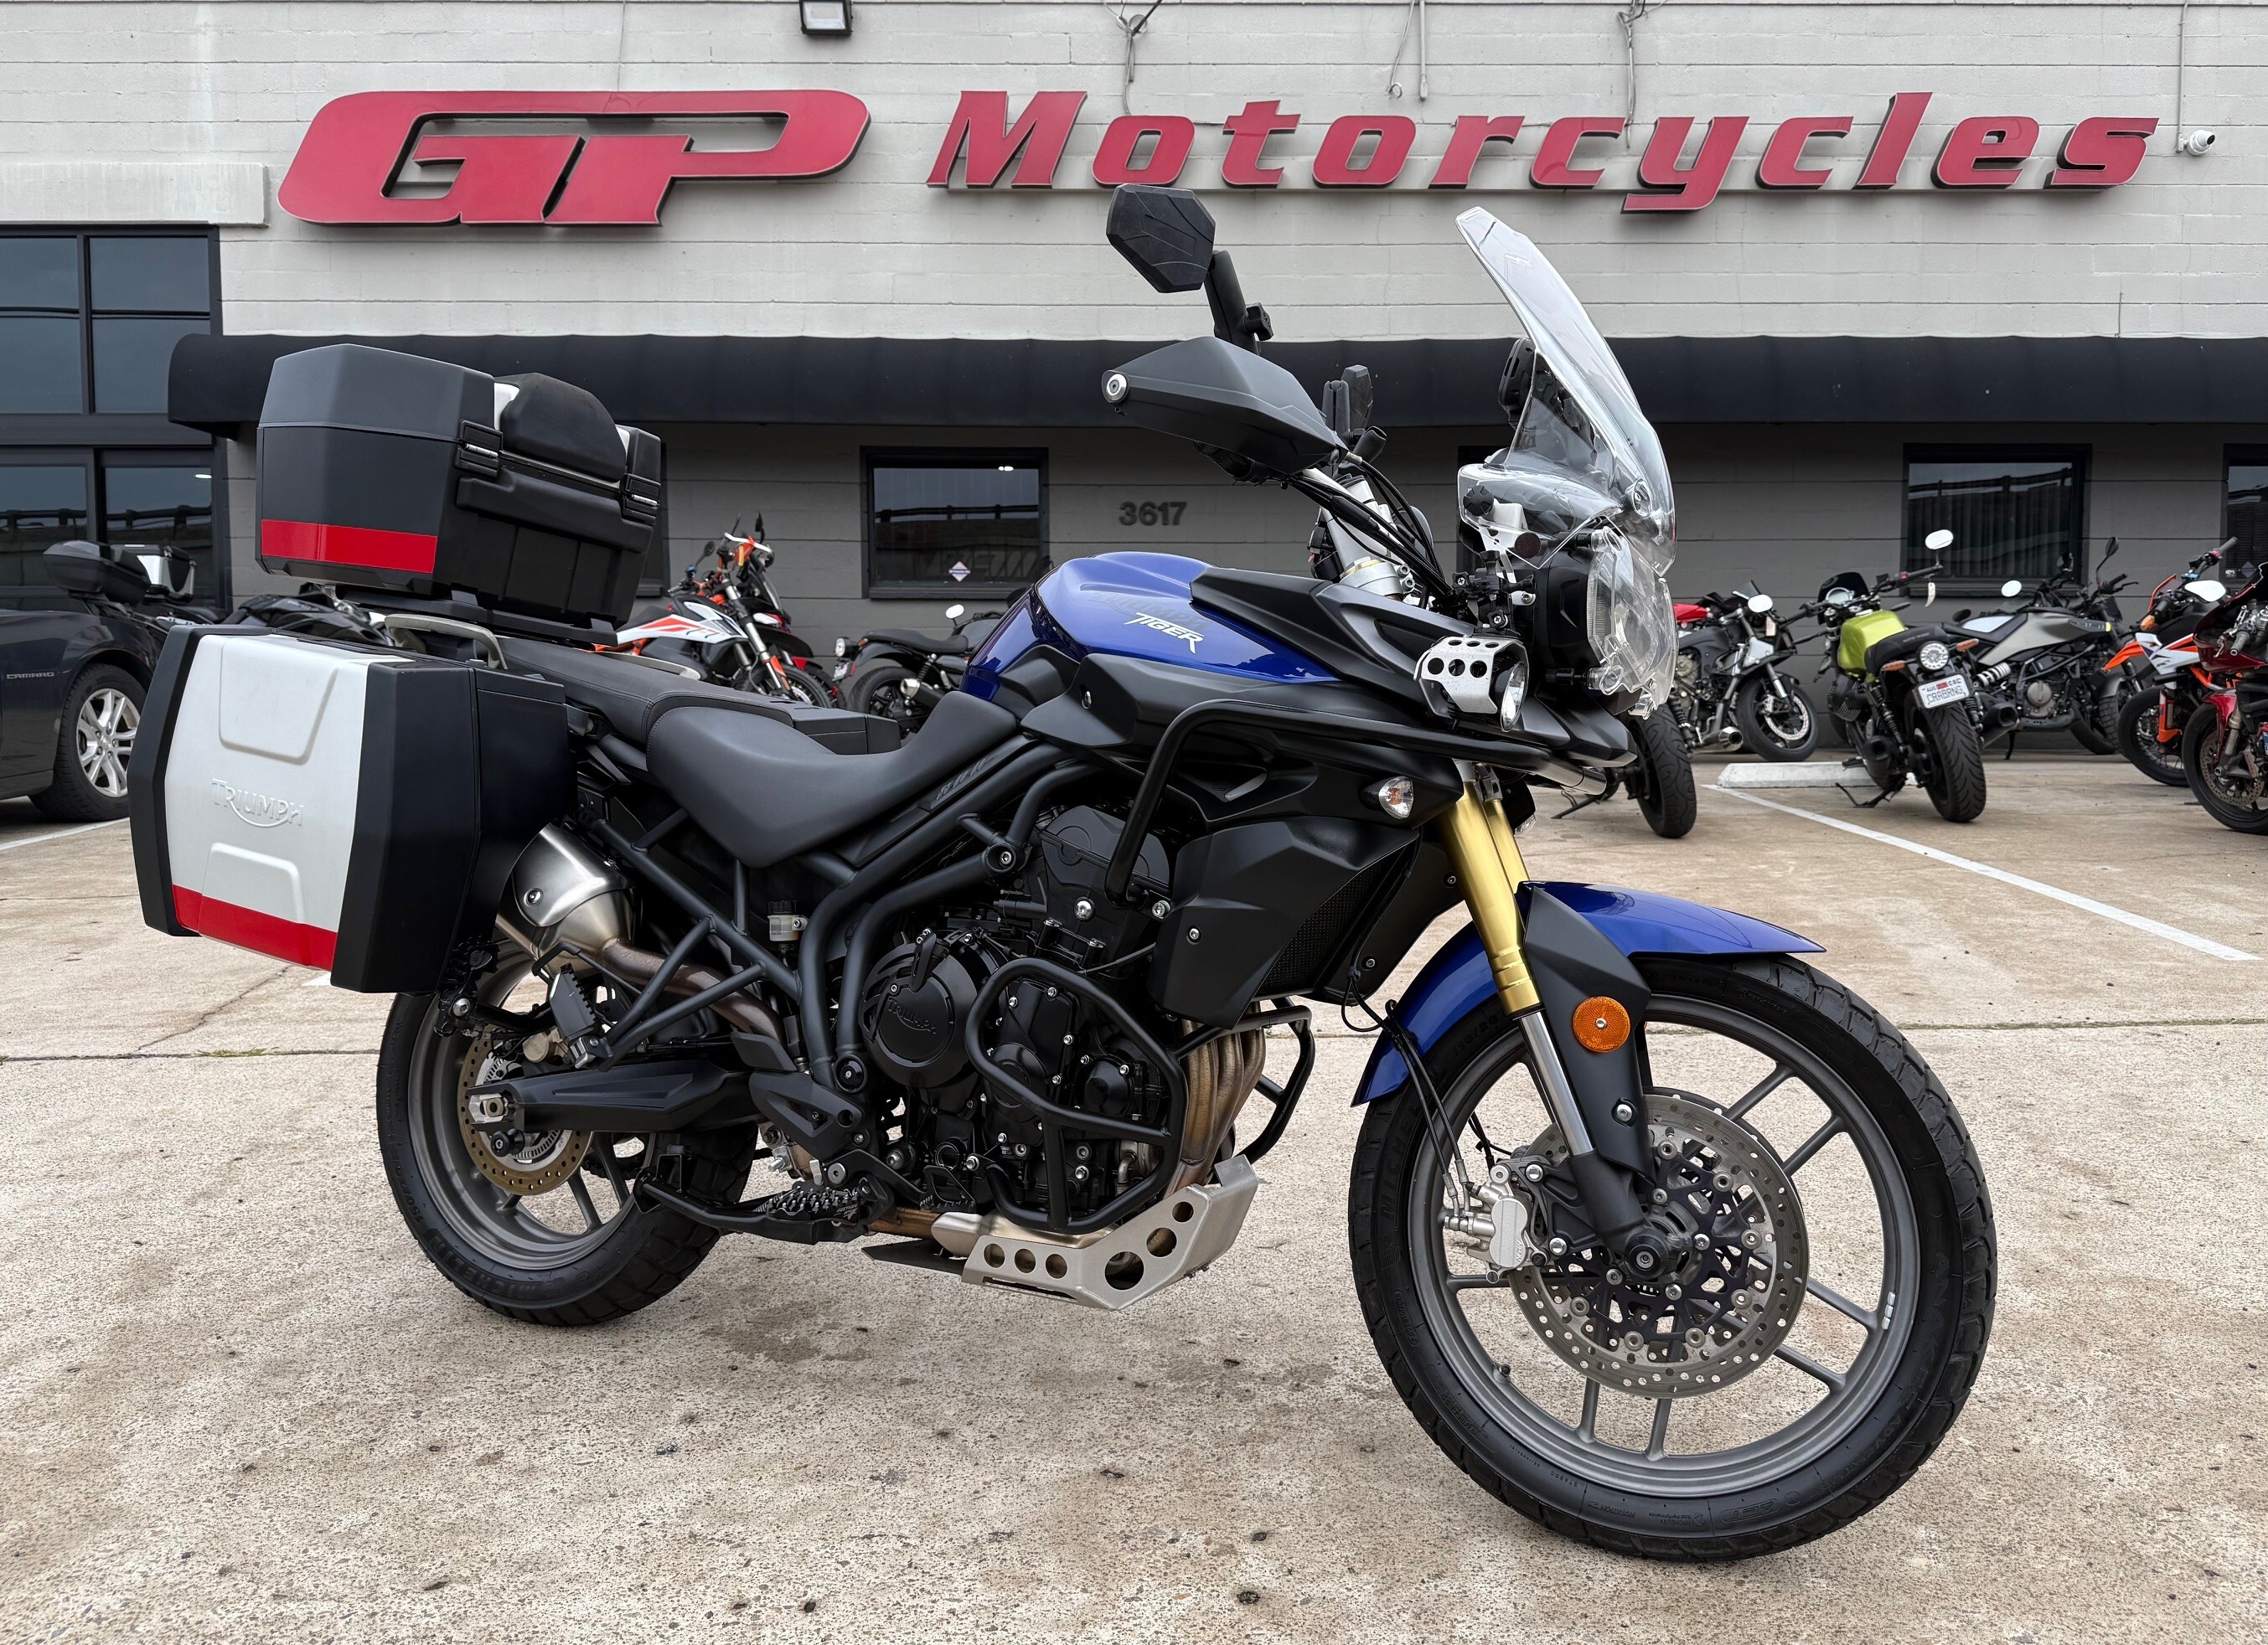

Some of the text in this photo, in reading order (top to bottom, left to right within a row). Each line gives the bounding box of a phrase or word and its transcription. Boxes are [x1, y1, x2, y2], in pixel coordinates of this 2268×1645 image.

[277, 90, 2160, 226] GP Motorcycles
[1119, 501, 1187, 527] 3617
[1124, 611, 1205, 654] TIGER
[211, 778, 304, 828] TRIUMPH
[428, 1234, 539, 1301] MICHELIN
